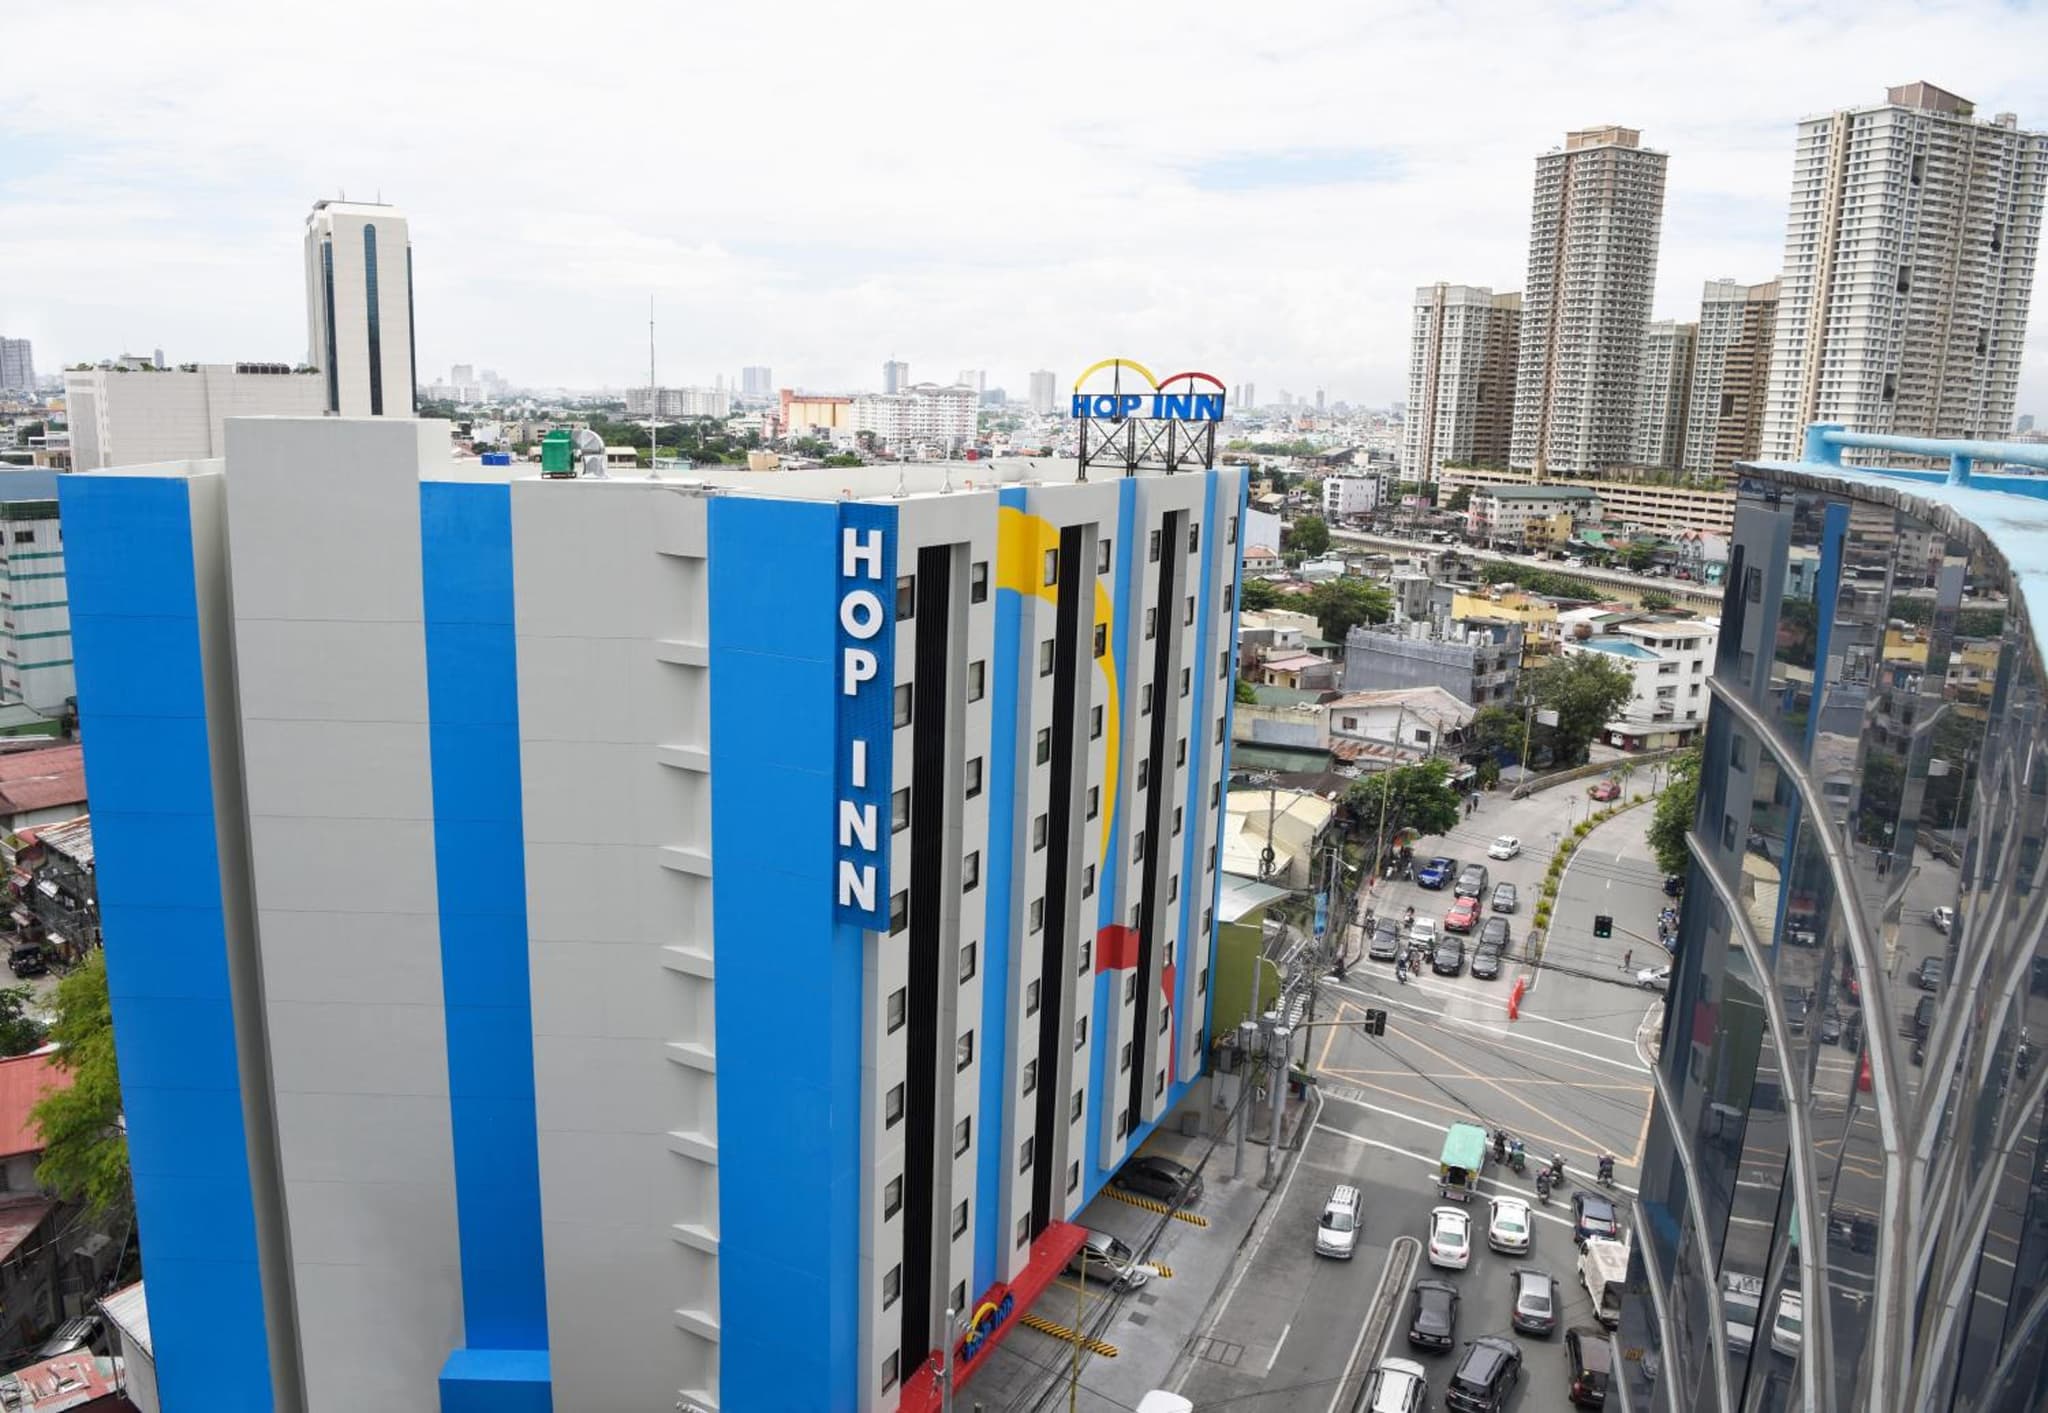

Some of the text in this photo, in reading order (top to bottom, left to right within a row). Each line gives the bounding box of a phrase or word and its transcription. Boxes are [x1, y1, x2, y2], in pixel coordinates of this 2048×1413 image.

[1072, 394, 1224, 422] HOP INN
[839, 527, 884, 912] HOP INN
